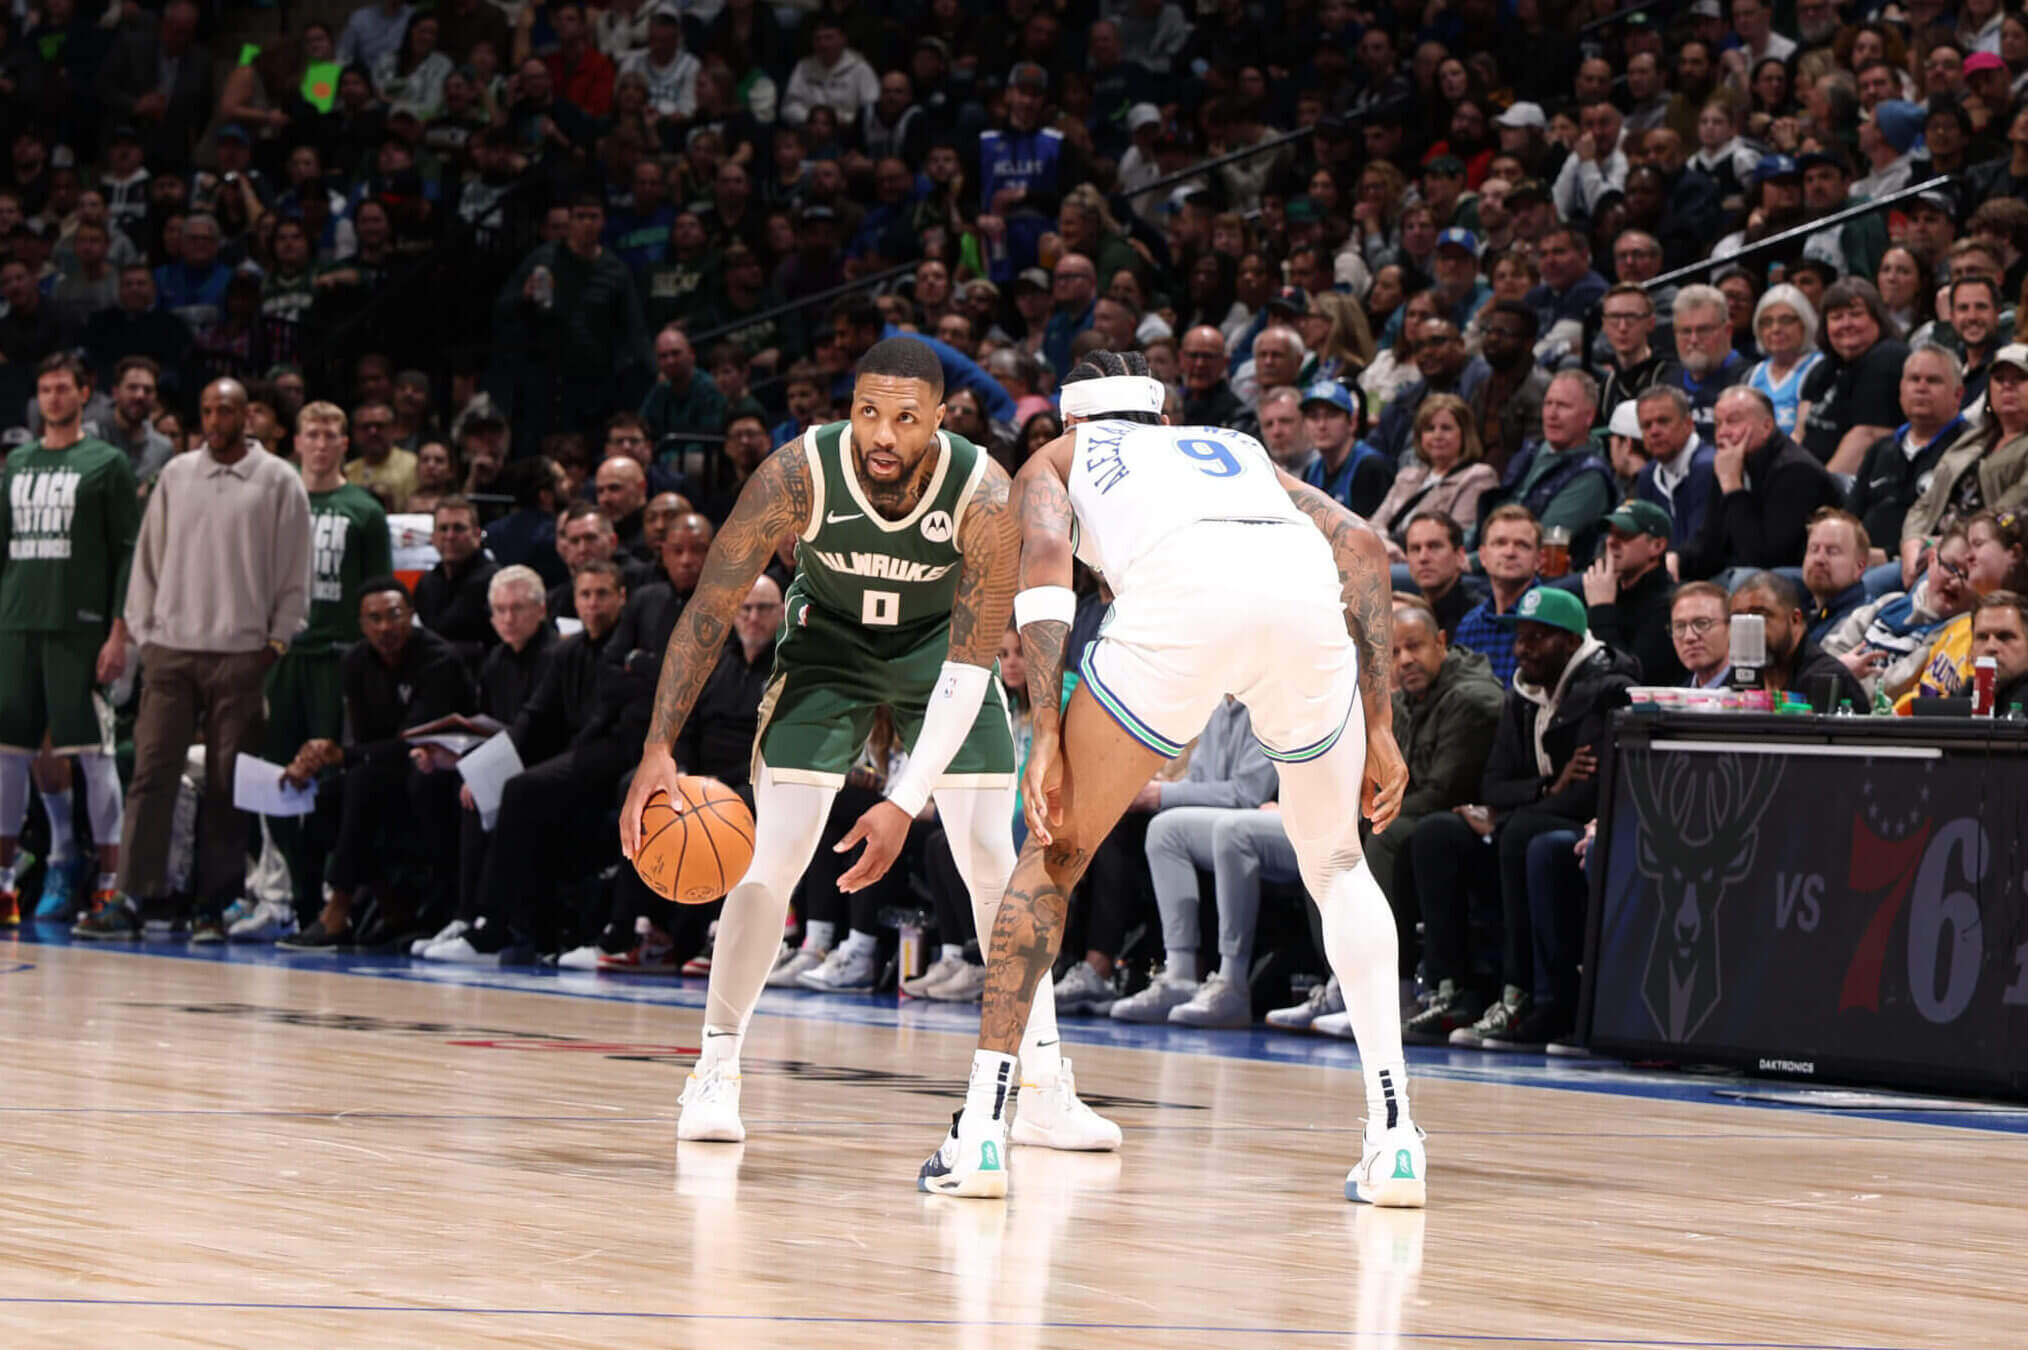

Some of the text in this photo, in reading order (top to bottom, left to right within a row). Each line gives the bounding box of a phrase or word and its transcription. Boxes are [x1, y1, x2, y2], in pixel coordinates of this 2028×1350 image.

[1176, 438, 1242, 477] 9
[862, 590, 900, 626] 0
[1775, 871, 1825, 932] VS
[1759, 1058, 1815, 1074] DAKTRONICS
